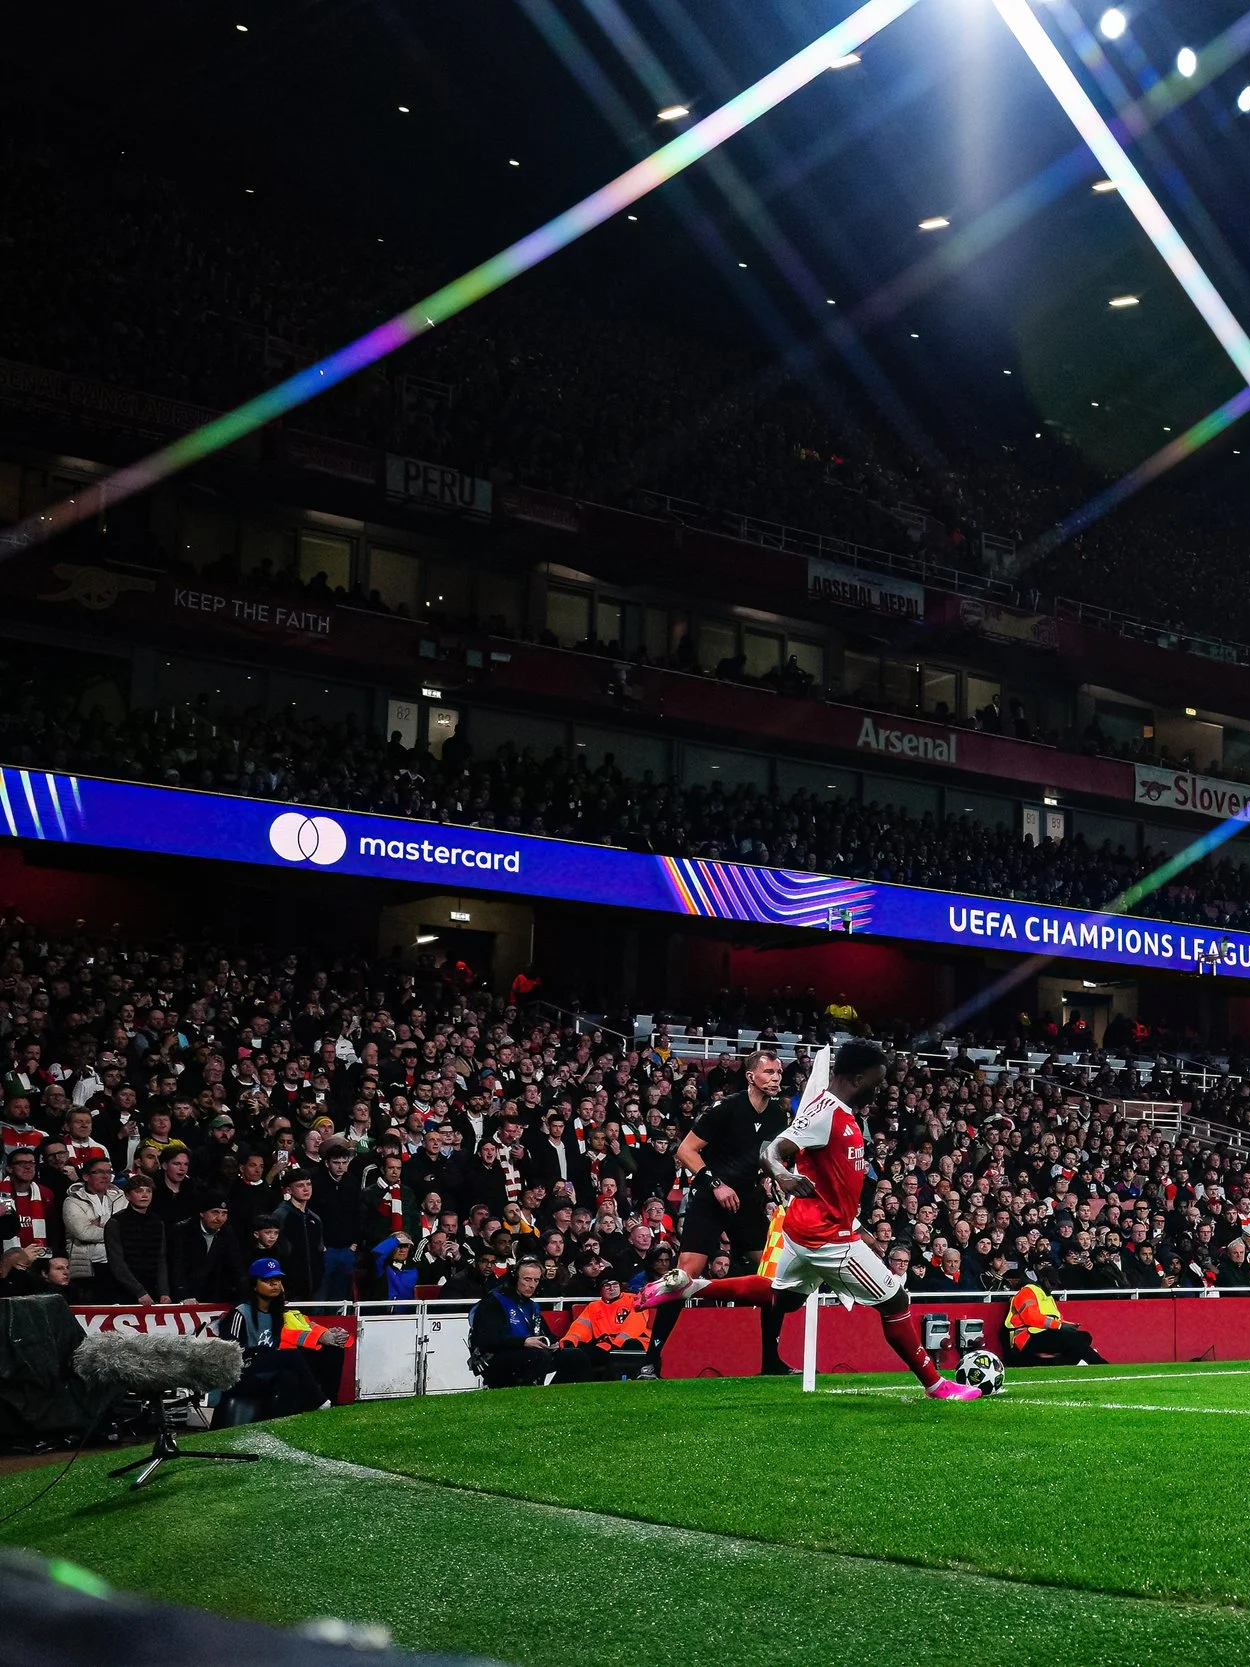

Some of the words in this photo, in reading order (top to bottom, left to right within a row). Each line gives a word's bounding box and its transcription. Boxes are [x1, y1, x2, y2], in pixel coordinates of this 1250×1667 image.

[405, 460, 475, 506] PERU
[174, 588, 226, 612] KEEP
[232, 599, 270, 622] THE
[275, 608, 330, 634] FAITH
[813, 575, 872, 610] ARSENAL
[856, 717, 956, 764] Arsenal
[360, 837, 520, 873] mastercard
[949, 906, 1017, 940] UEFA
[1025, 916, 1174, 958] CHAMPIONS
[432, 1321, 442, 1332] 29
